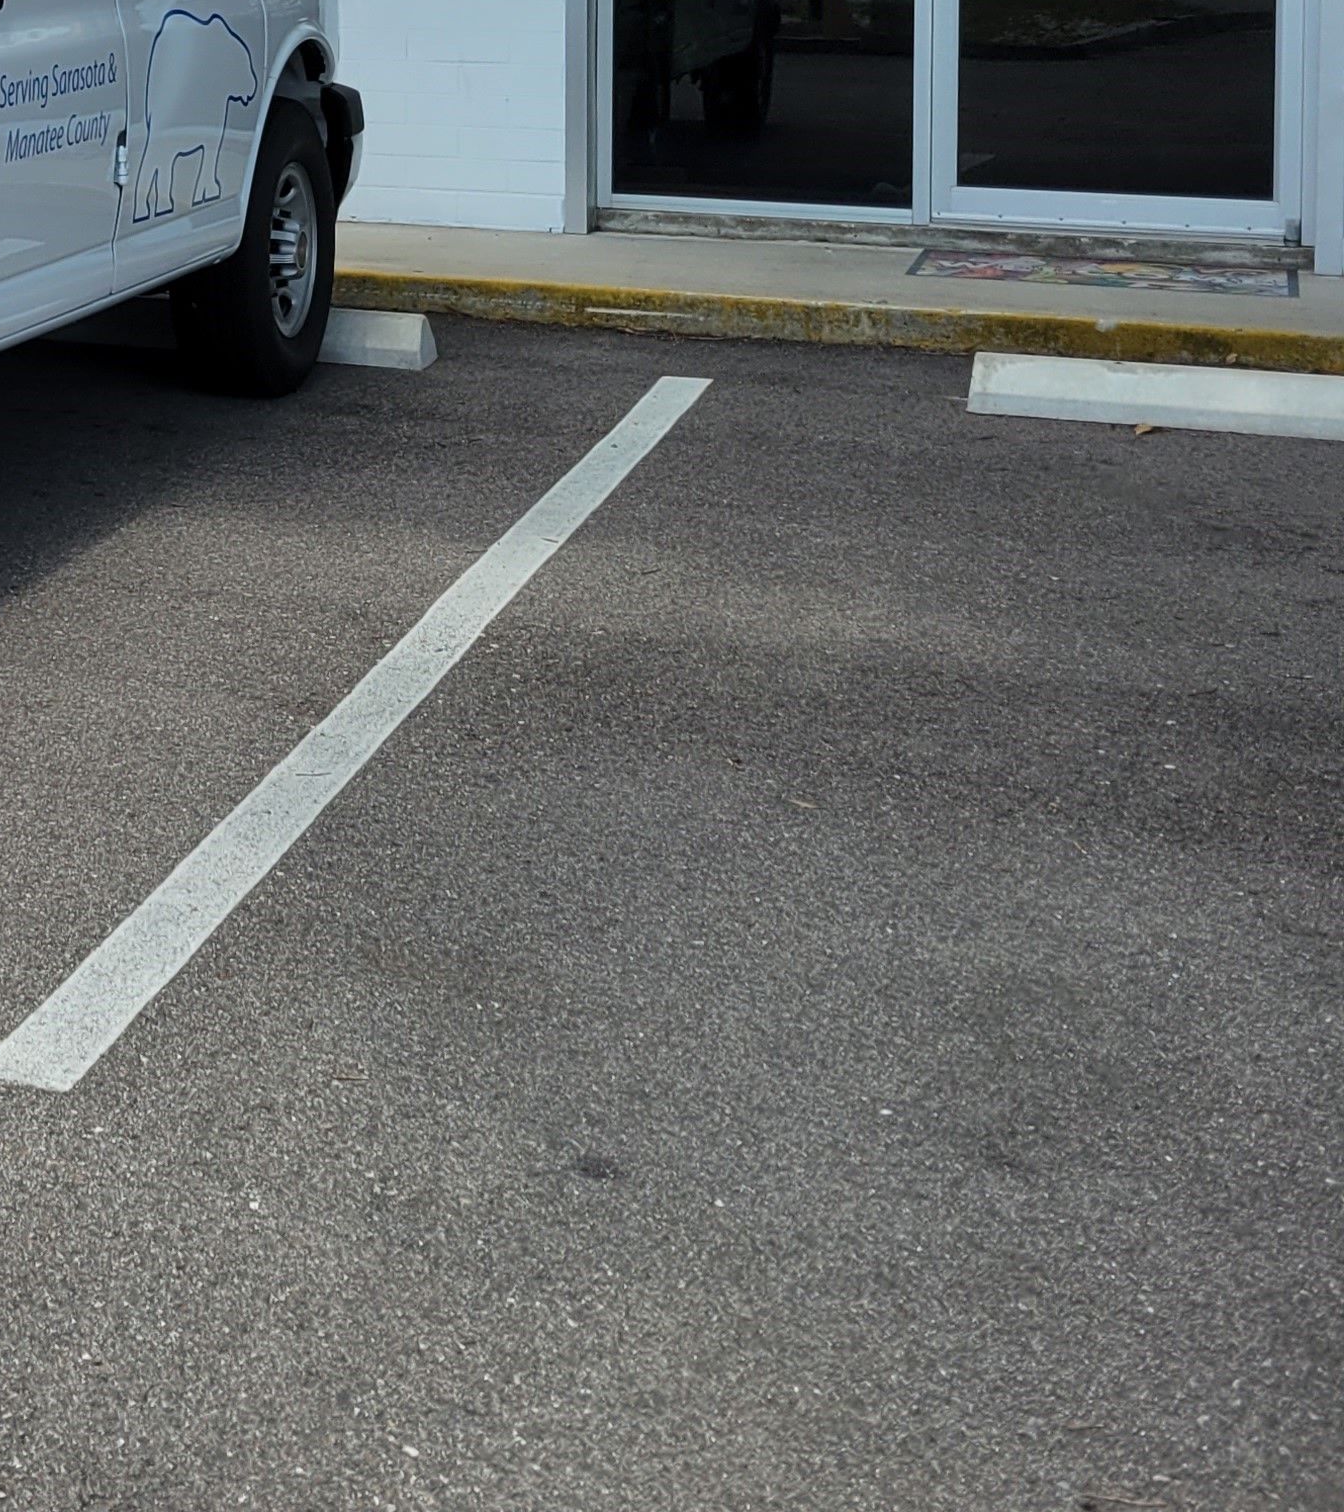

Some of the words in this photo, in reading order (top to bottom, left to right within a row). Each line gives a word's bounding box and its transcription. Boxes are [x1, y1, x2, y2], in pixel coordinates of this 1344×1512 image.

[0, 75, 48, 109] Serving
[51, 60, 106, 98] Sarasota
[108, 52, 117, 83] &
[5, 126, 64, 163] Manatee
[66, 110, 111, 147] County
